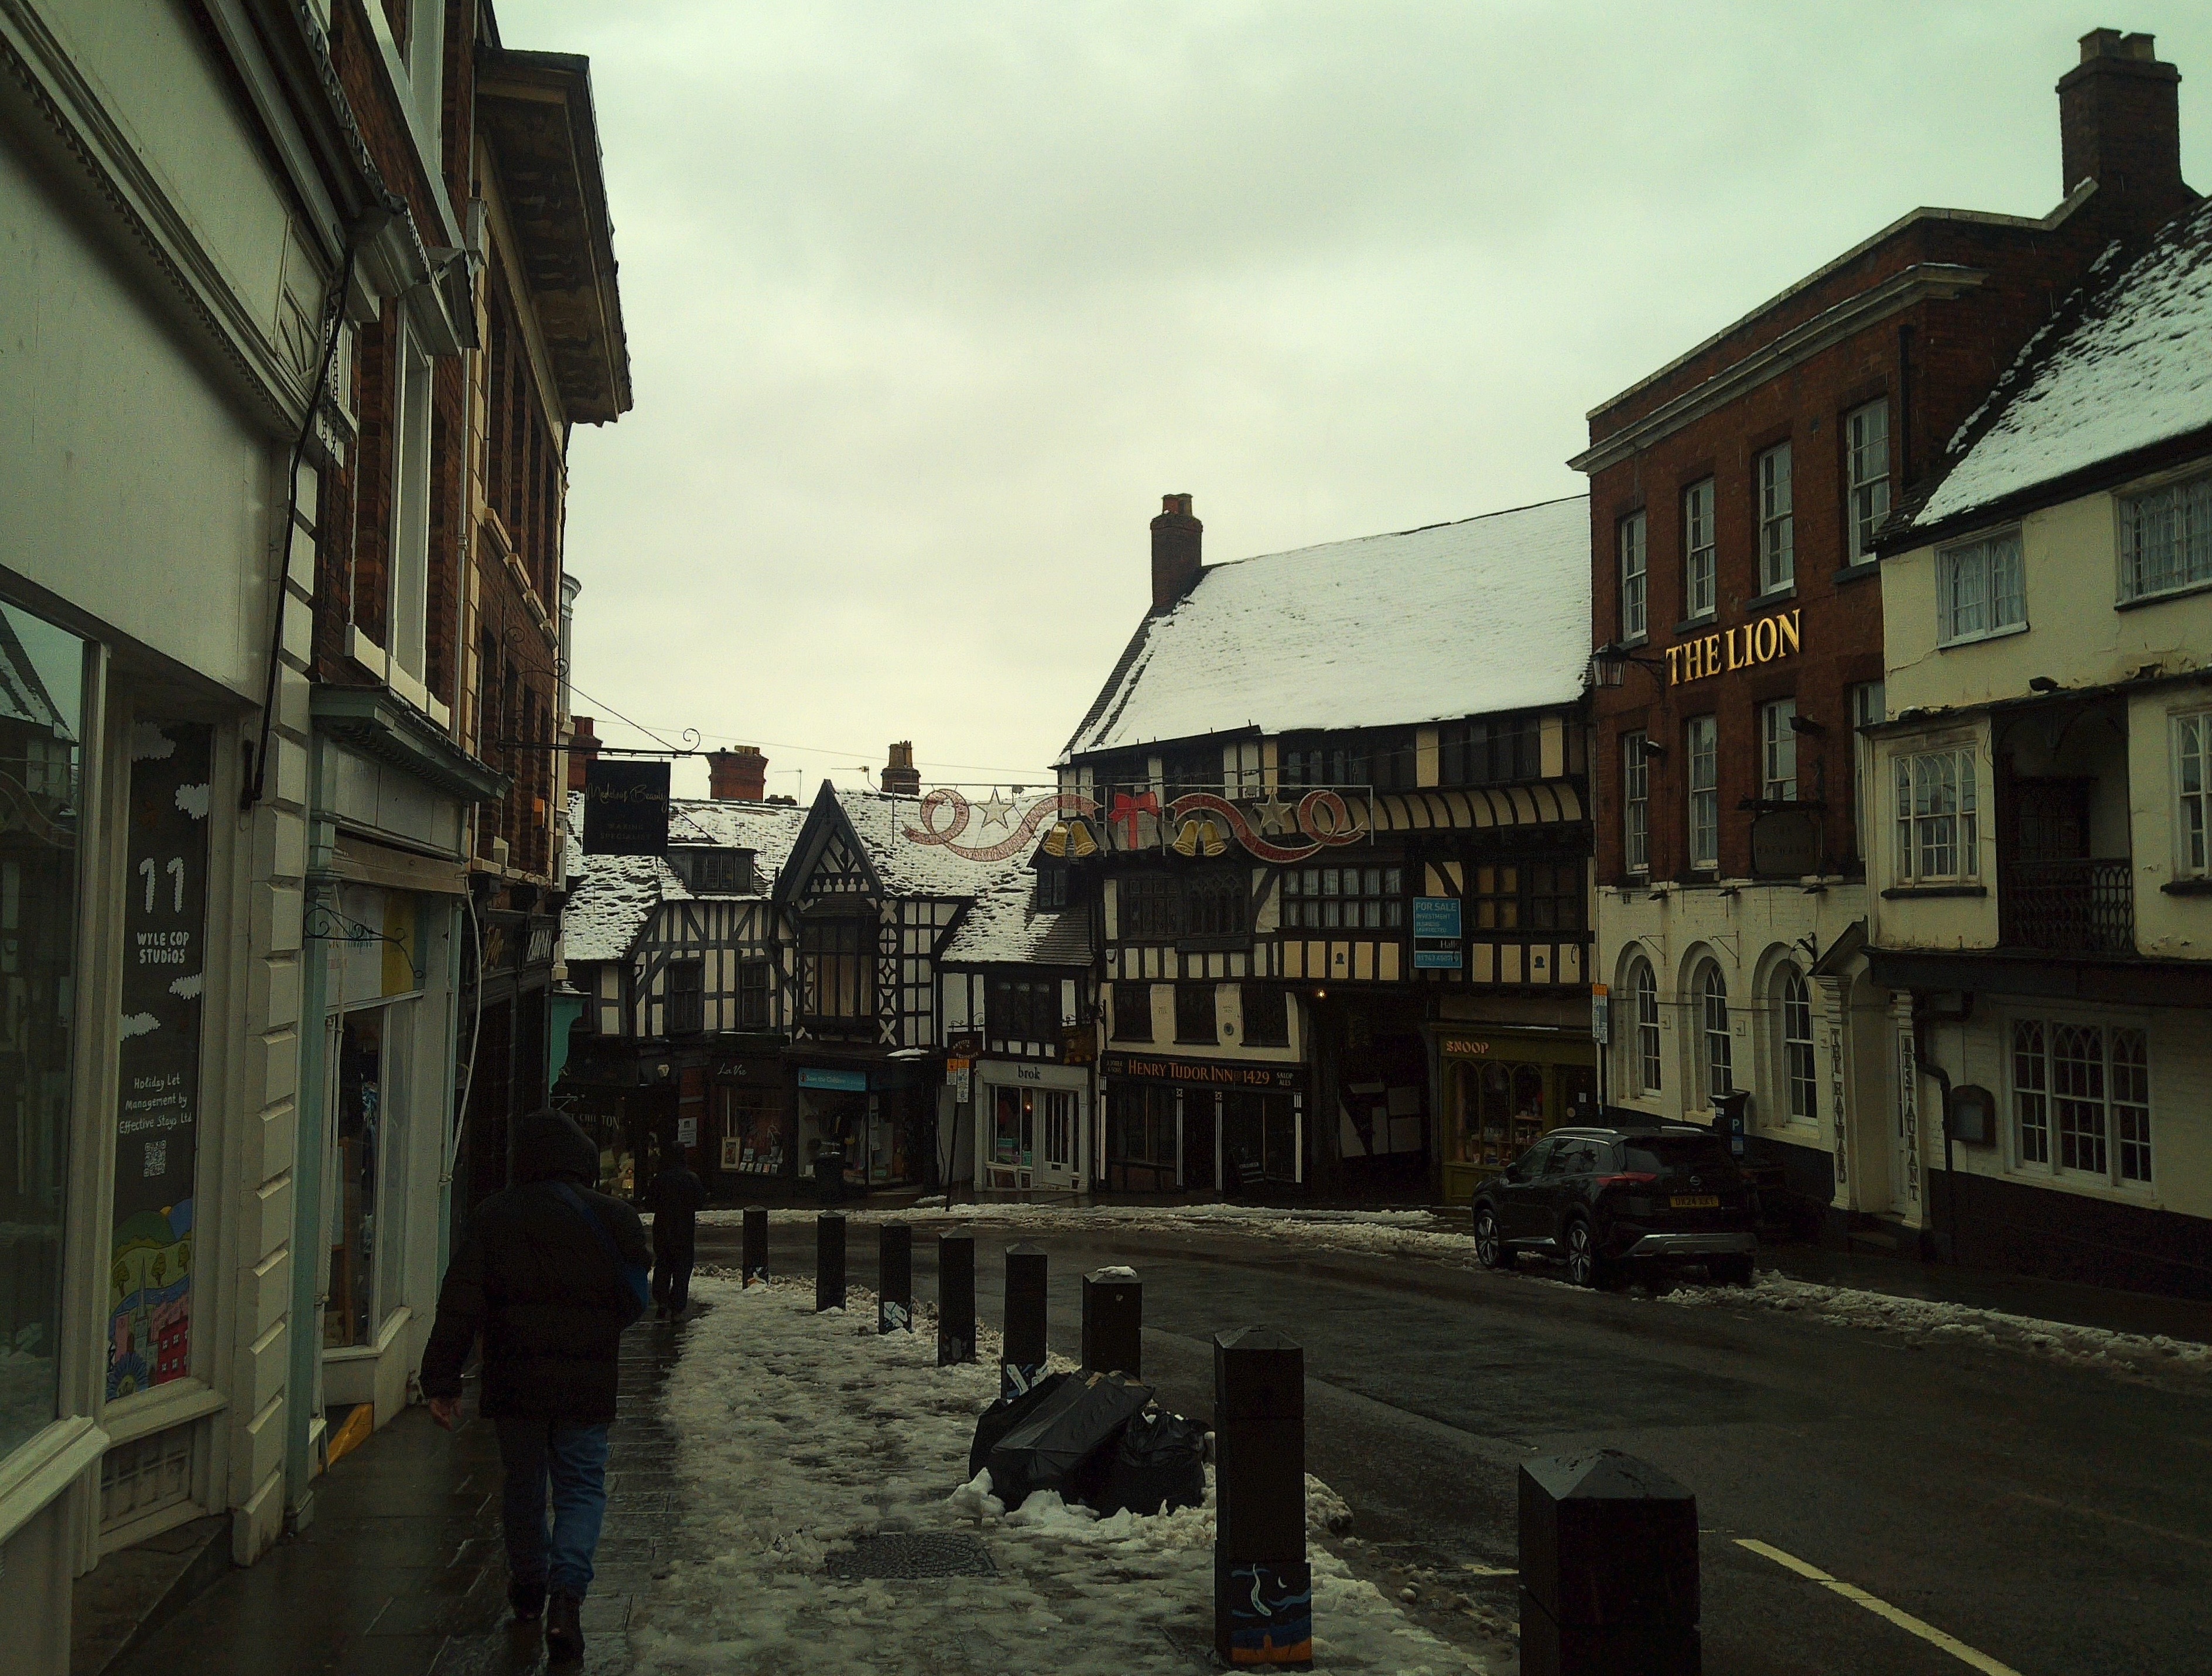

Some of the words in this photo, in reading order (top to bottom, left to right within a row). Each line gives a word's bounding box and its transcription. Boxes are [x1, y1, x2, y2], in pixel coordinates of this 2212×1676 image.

[1666, 633, 1722, 686] THE
[1726, 609, 1801, 672] LION
[139, 856, 184, 914] 11
[1416, 902, 1433, 911] FOR
[1435, 903, 1457, 912] SALE
[137, 931, 166, 946] WYLE
[169, 931, 190, 946] COP
[1446, 1040, 1489, 1054] SNOOP
[1831, 1029, 1842, 1074] THE
[717, 1063, 732, 1075] La
[733, 1064, 747, 1076] Vie
[1018, 1065, 1041, 1080] brok
[1129, 1059, 1166, 1077] HENRY
[1168, 1062, 1210, 1080] TUDOR
[1211, 1065, 1233, 1083] INN
[1243, 1070, 1270, 1084] 1429
[1276, 1071, 1294, 1080] SALOP
[134, 1076, 165, 1092] Holiday
[167, 1072, 180, 1086] Let
[125, 1093, 176, 1111] Management
[179, 1092, 187, 1108] by
[119, 1117, 154, 1134] Effective
[156, 1114, 177, 1130] Stays
[180, 1112, 192, 1124] Ltd
[1732, 1118, 1740, 1131] P
[1905, 1037, 1919, 1201] RESTAURANT
[1833, 1082, 1846, 1183] HAYWARD
